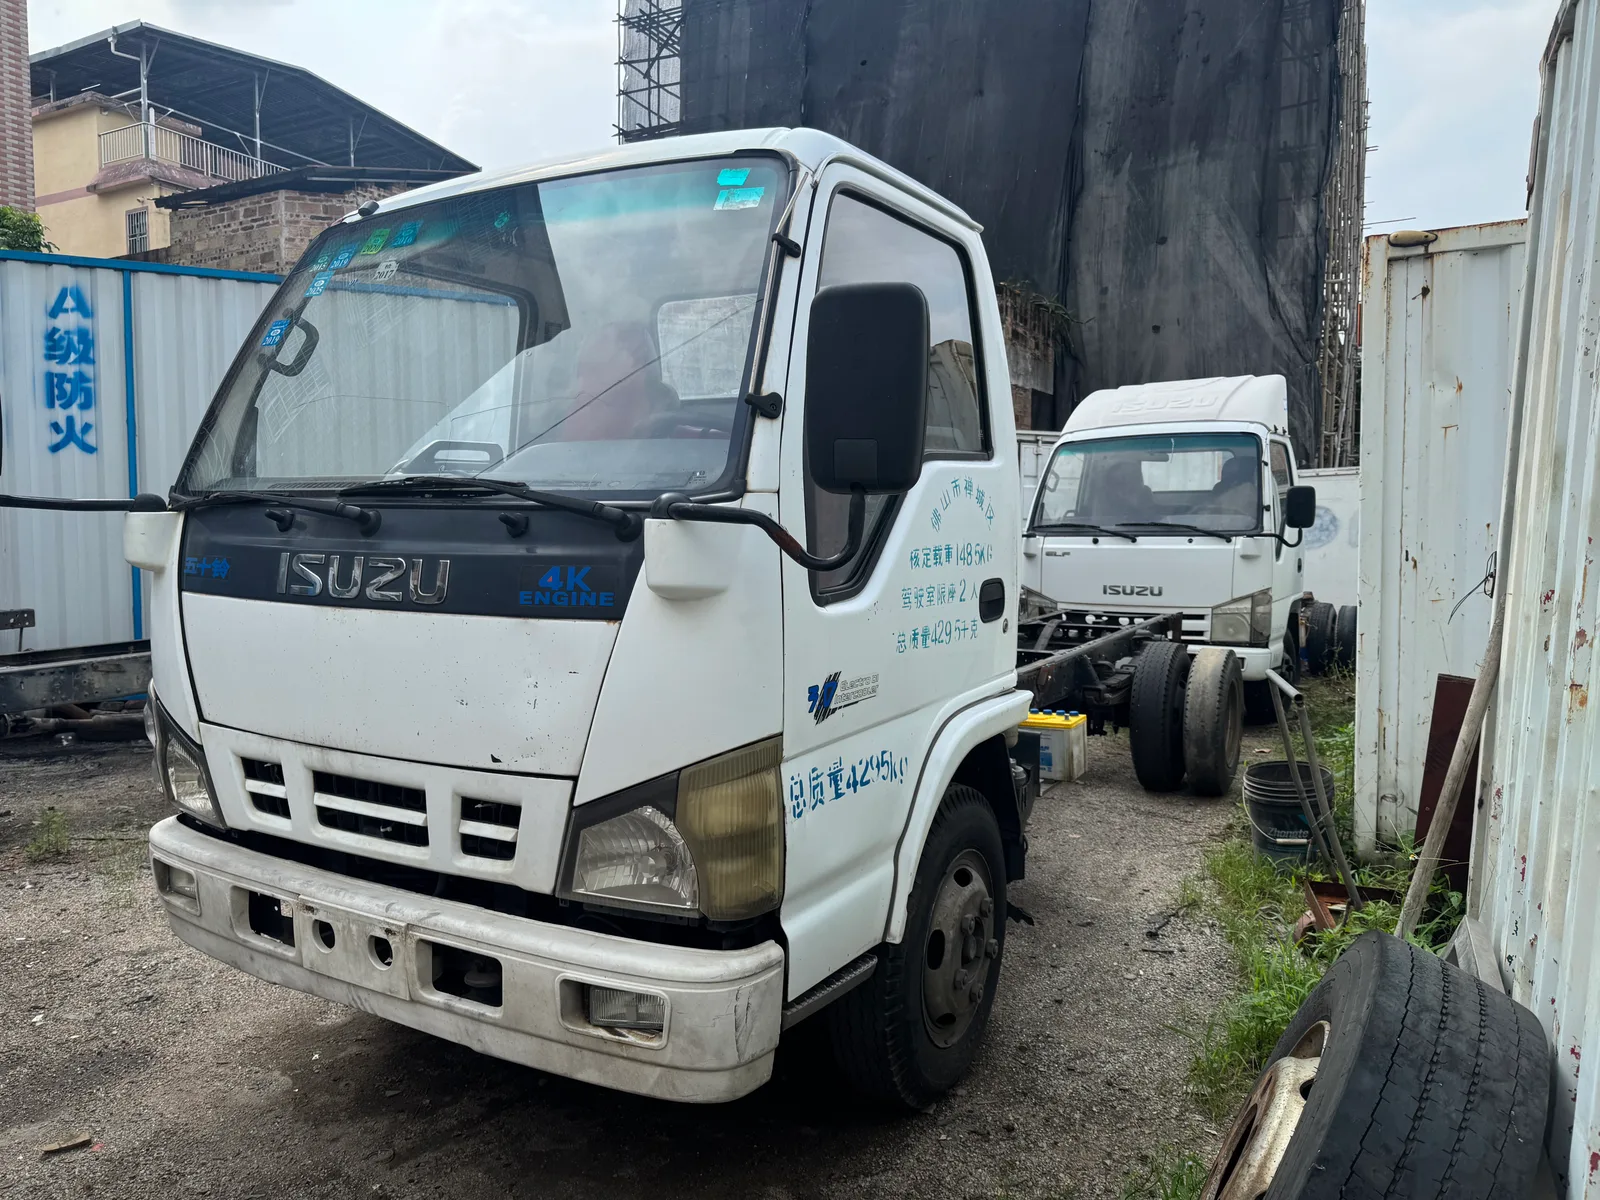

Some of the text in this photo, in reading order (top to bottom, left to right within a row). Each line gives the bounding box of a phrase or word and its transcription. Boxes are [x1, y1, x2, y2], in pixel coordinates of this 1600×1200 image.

[373, 269, 394, 280] 2017
[45, 286, 98, 454] A级防火
[1111, 395, 1219, 414] ISUZU
[184, 557, 230, 580] 五十铃
[276, 552, 450, 605] ISUZU
[538, 566, 592, 592] 4K
[519, 591, 615, 606] ENGINE
[1102, 584, 1163, 597] ISUZU
